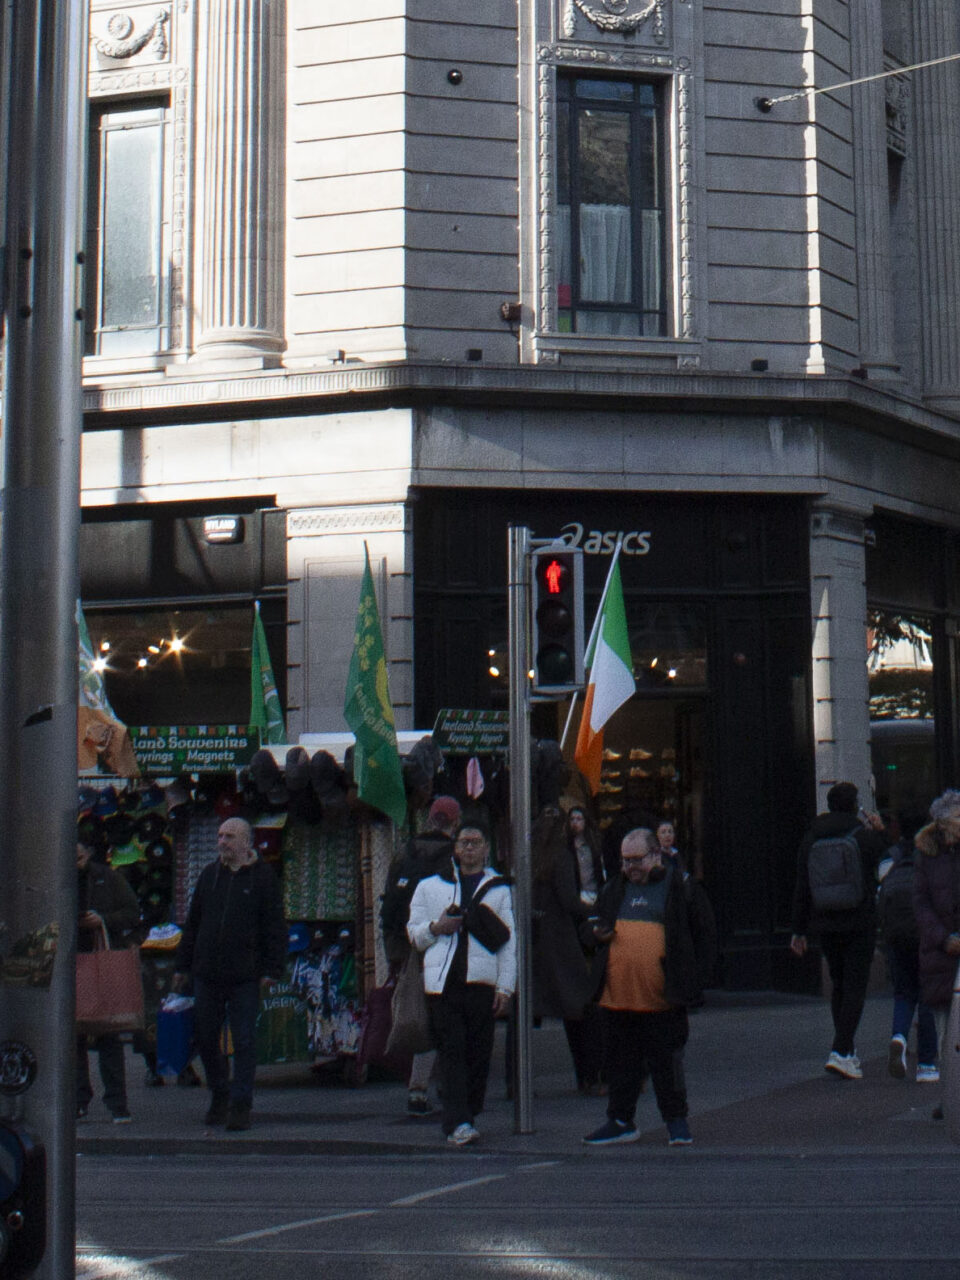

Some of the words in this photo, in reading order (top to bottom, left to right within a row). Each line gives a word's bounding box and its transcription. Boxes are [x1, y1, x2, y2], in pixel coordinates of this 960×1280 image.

[133, 736, 166, 749] land
[168, 736, 248, 749] Souvenirs
[135, 750, 175, 763] eyrings
[187, 749, 236, 763] Magnets
